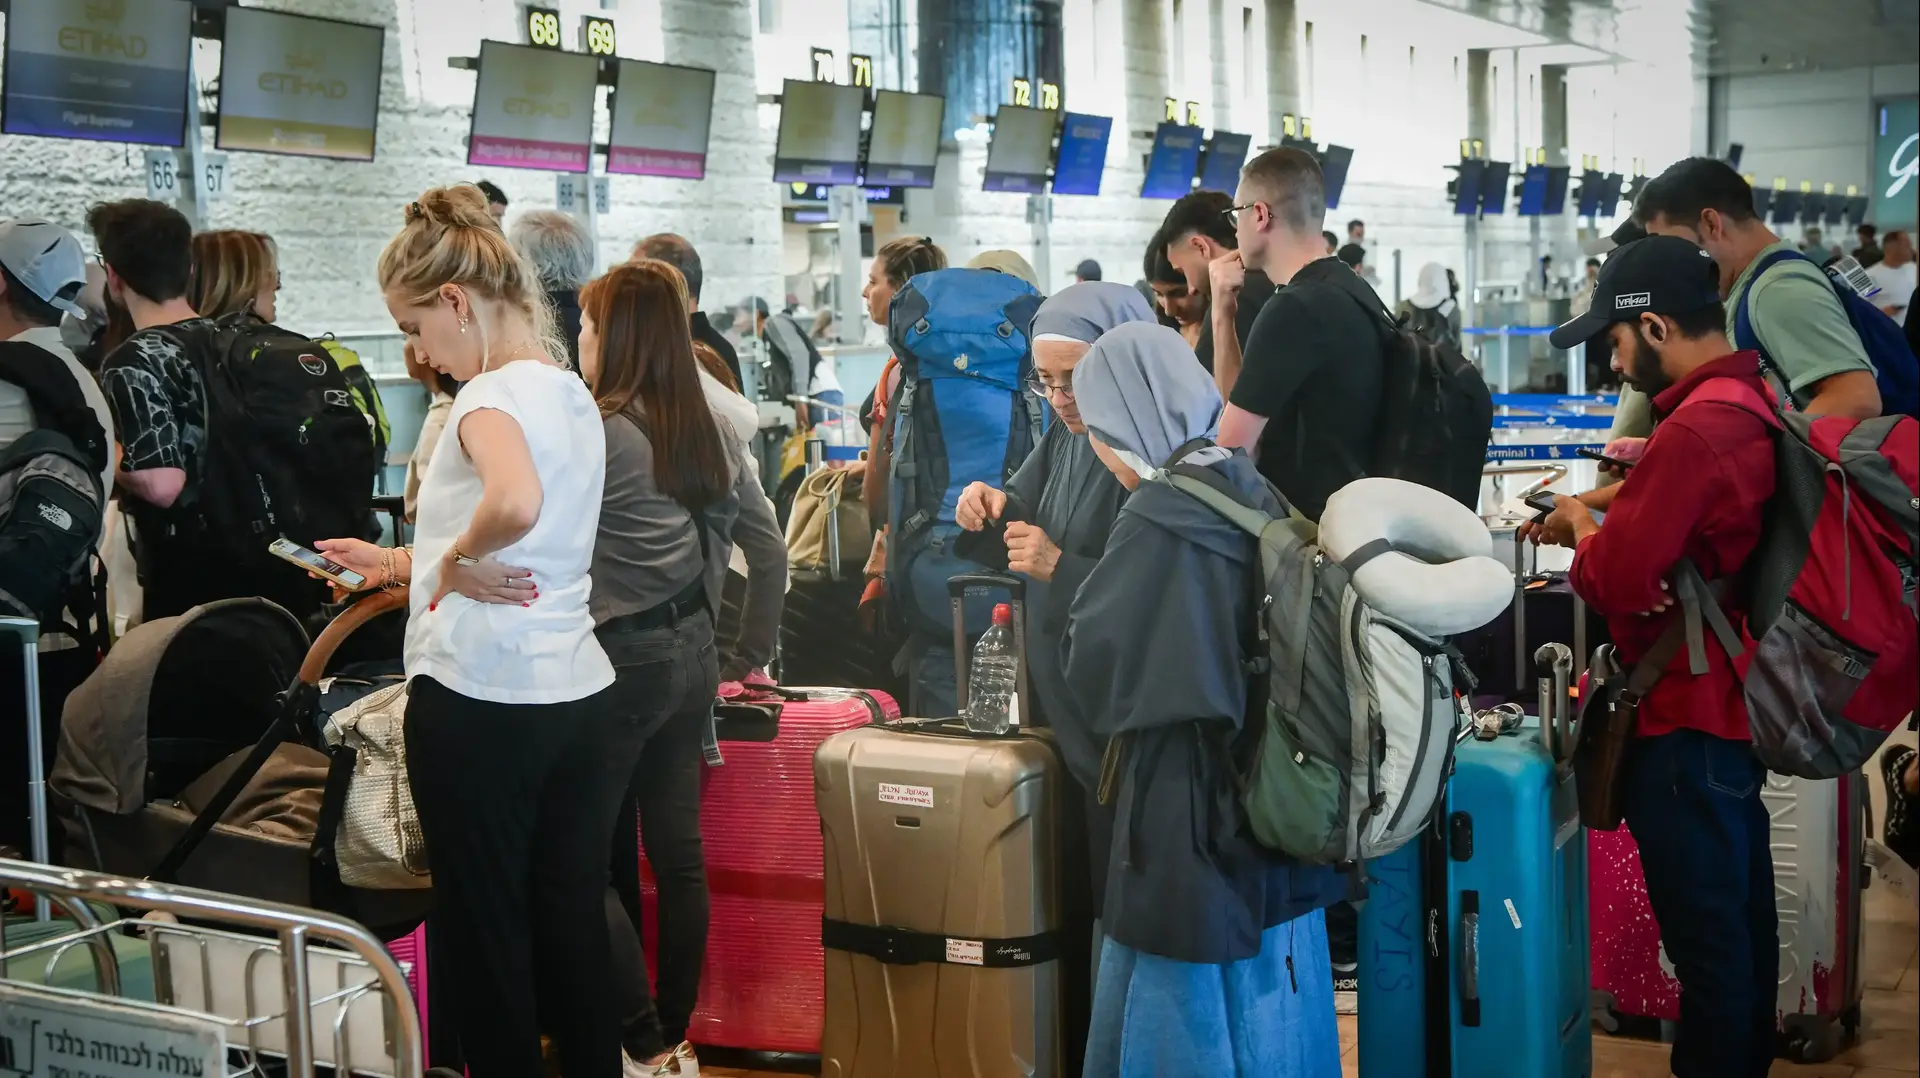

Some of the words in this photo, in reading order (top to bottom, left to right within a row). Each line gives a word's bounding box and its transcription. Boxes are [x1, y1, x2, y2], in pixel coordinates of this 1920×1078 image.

[58, 26, 147, 59] ETIHAD
[530, 11, 559, 46] 68
[588, 20, 615, 55] 69
[852, 56, 871, 87] 71
[1014, 79, 1030, 106] 72
[152, 160, 174, 190] 66
[206, 164, 223, 191] 67
[1530, 448, 1535, 457] 1
[1334, 978, 1358, 990] HOK
[45, 1028, 86, 1058] בלבד
